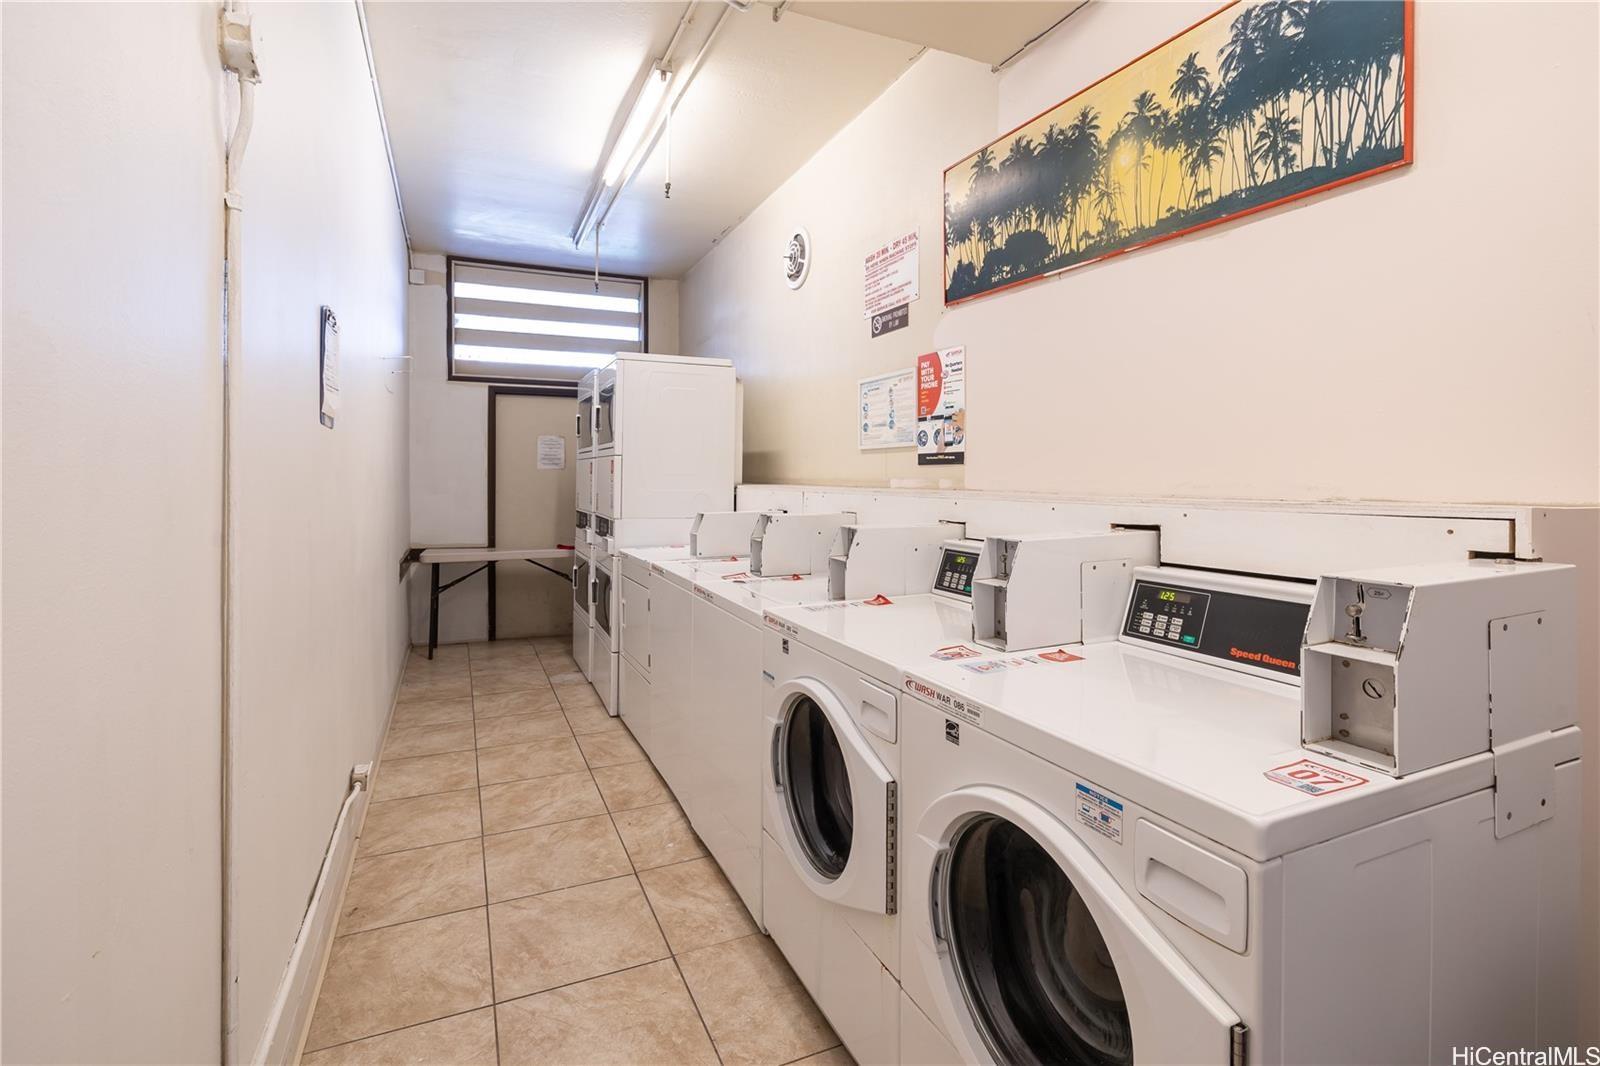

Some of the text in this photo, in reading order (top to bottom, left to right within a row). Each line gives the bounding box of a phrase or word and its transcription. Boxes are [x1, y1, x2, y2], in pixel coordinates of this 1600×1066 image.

[921, 361, 931, 369] PAY
[921, 368, 935, 377] WITH
[921, 375, 935, 384] YOUR
[921, 380, 939, 390] PHONE
[1230, 647, 1296, 669] Speed Queen
[914, 682, 966, 712] WASH WAR 086
[1287, 769, 1345, 785] 07
